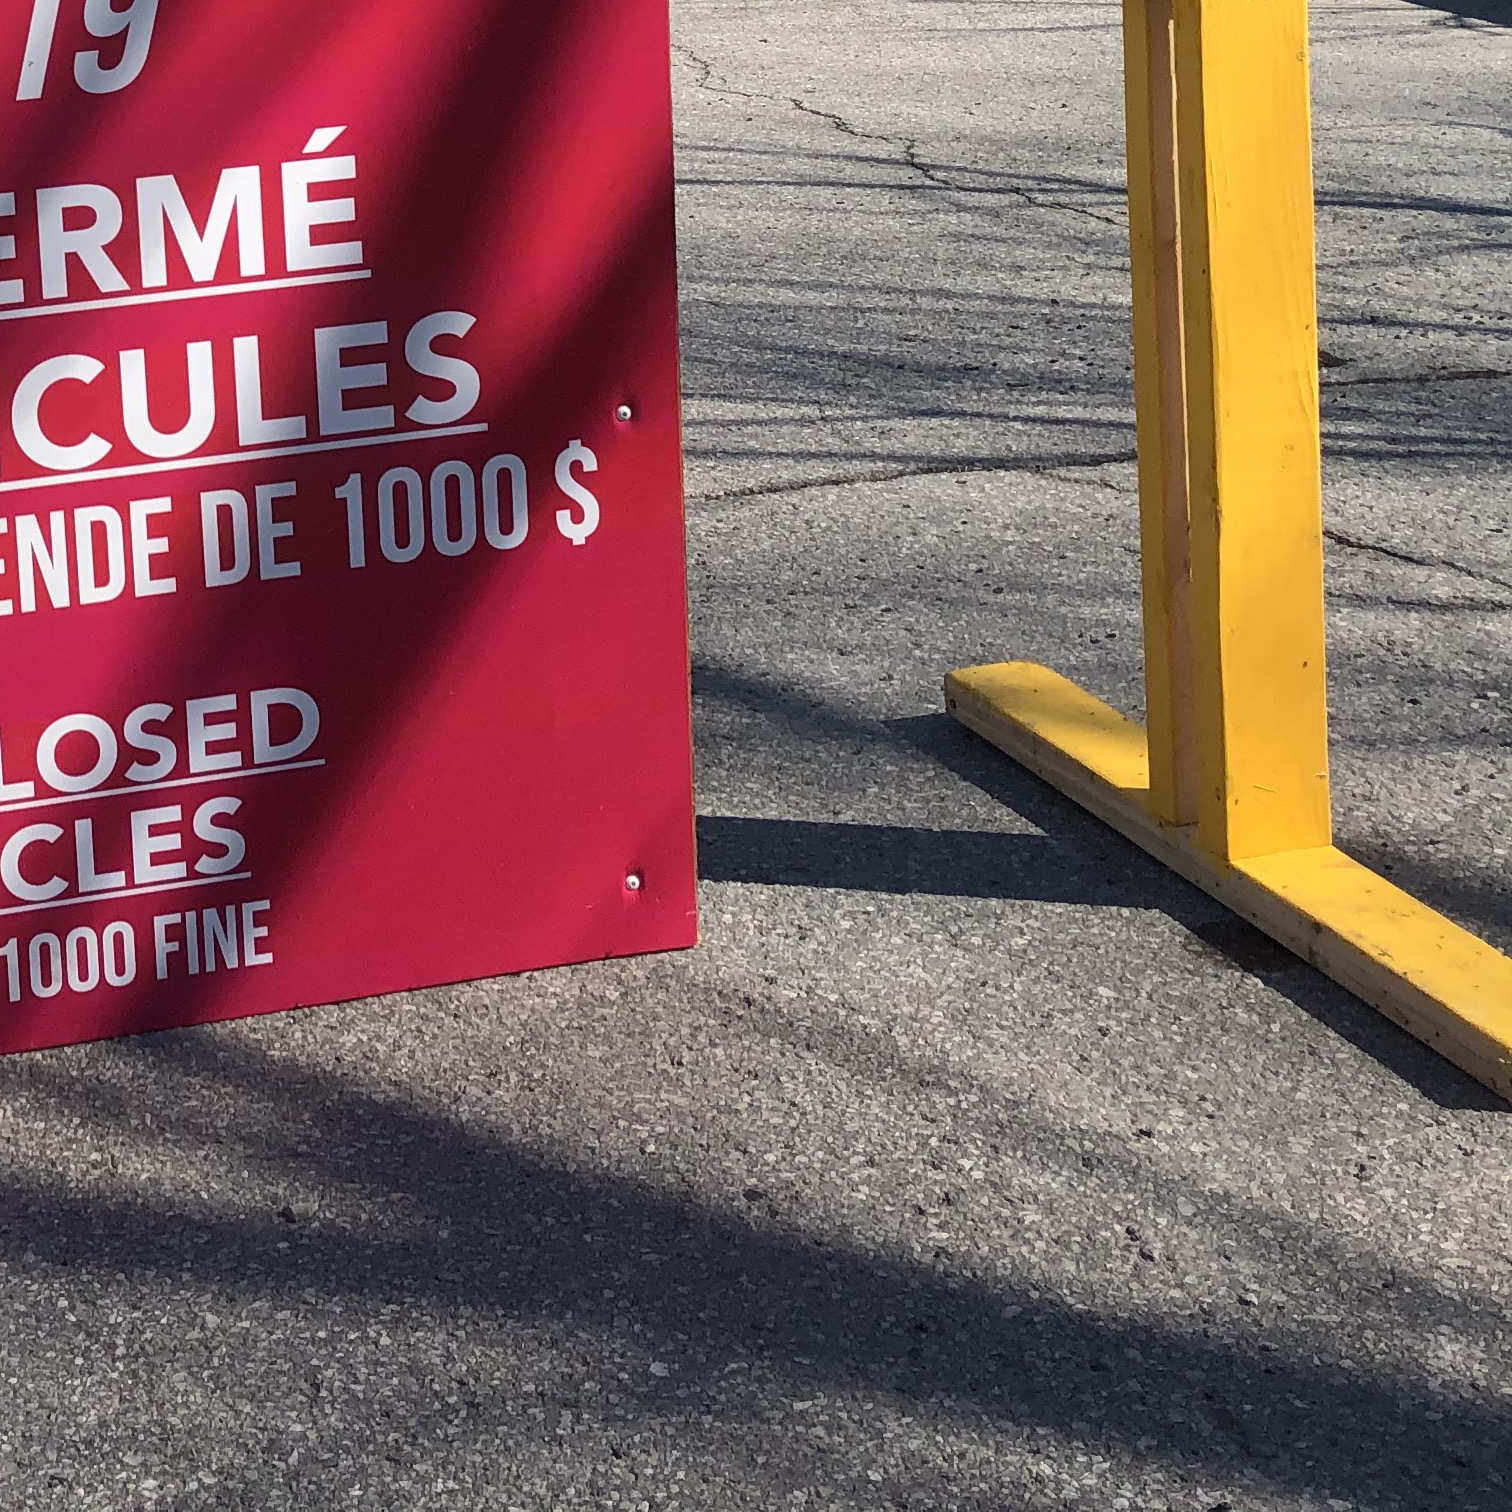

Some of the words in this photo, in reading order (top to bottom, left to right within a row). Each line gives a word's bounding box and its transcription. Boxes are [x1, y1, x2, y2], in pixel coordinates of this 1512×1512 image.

[199, 481, 303, 588] DE
[335, 454, 529, 575] 1000
[554, 439, 601, 546] $
[153, 899, 274, 982] FINE
